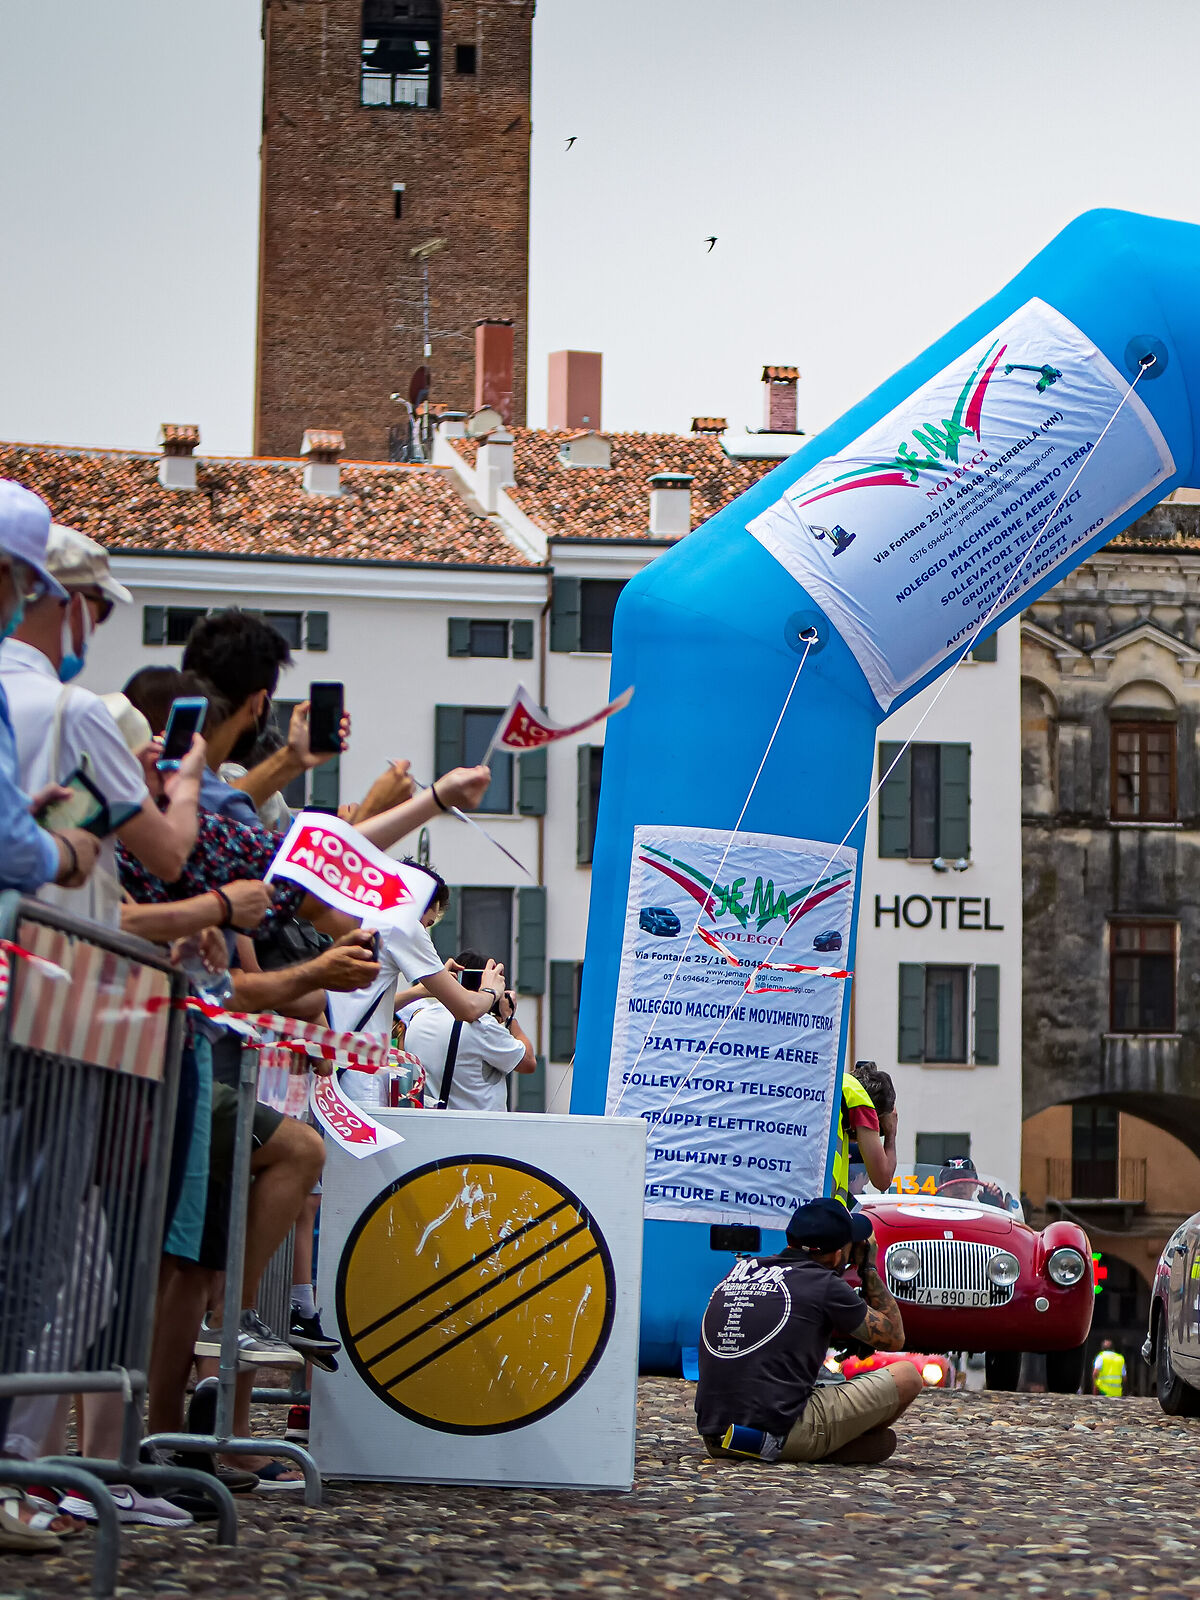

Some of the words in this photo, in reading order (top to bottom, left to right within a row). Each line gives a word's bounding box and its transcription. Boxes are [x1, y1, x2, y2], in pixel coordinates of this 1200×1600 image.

[873, 549, 890, 564] Via
[889, 521, 927, 552] Fontane
[926, 497, 956, 524] 25/1B
[955, 475, 985, 499] 46048
[983, 430, 1041, 477] ROVERBELLA
[1040, 411, 1064, 434] (MN)
[925, 449, 990, 501] NOLEGGI
[908, 546, 928, 565] 0376
[926, 527, 954, 552] 694642
[958, 445, 1056, 527] prenotazioni@jemanoleggi.com
[941, 467, 1014, 527] www.jemanoleggi.com
[895, 559, 948, 604] NOLEGGIO
[947, 515, 1002, 562] MACCHINE
[1000, 467, 1062, 519] MOVIMENTO
[1060, 440, 1095, 470] TERRA
[950, 518, 1024, 580] PIATTAFORME
[1025, 490, 1058, 523] AEREE
[940, 545, 1013, 607] SOLLEVATORI
[1013, 489, 1083, 548] TELESCOPICI
[1022, 577, 1030, 587] E
[1031, 546, 1069, 579] MOLTO
[1070, 517, 1105, 548] ALTRO
[961, 573, 1002, 607] GRUPPI
[977, 569, 1024, 610] PULMINI
[1025, 562, 1034, 572] 9
[1034, 534, 1068, 564] POSTI
[310, 830, 384, 886] 1000
[291, 847, 382, 907] MIGLIA
[874, 895, 1004, 931] HOTEL
[635, 951, 649, 961] Via
[713, 931, 784, 948] NOLEGGI
[683, 974, 710, 984] 694642
[628, 998, 682, 1016] NOLEGGIO
[685, 1002, 746, 1022] MACCHINE
[749, 1008, 810, 1029] MOVIMENTO
[811, 1014, 834, 1031] TERRA
[643, 1036, 770, 1060] PIATTAFORME
[774, 1047, 819, 1065] AEREE
[622, 1072, 734, 1093] SOLLEVATORI
[740, 1081, 826, 1103] TELESCOPICI
[640, 1111, 703, 1127] GRUPPI
[708, 1116, 808, 1137] ELETTROGENI
[654, 1148, 728, 1166] PULMINI
[732, 1154, 743, 1167] 9
[747, 1156, 792, 1173] POSTI
[720, 1190, 729, 1203] E
[735, 1191, 786, 1209] MOLTO
[892, 1175, 938, 1195] 134
